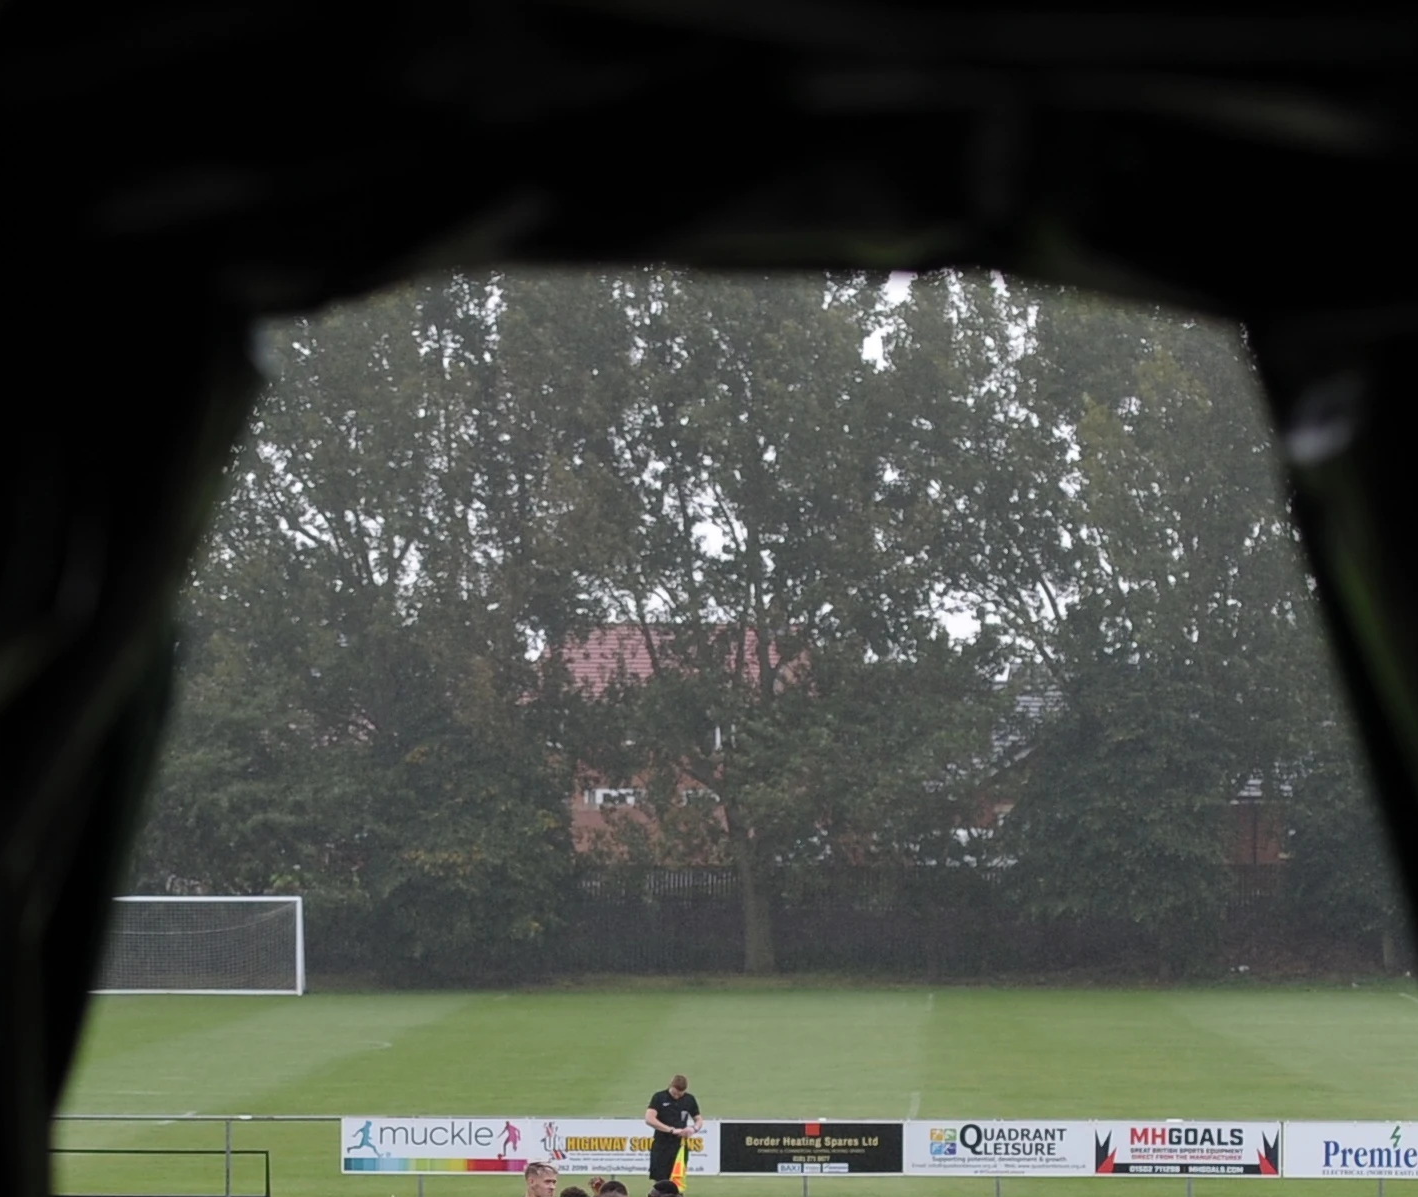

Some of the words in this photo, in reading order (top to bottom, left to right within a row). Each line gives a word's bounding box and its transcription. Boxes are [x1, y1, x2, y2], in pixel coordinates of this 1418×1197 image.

[379, 1121, 493, 1146] muckle
[959, 1124, 1067, 1156] QUADRANT
[1130, 1128, 1244, 1146] MHGOALS
[566, 1136, 627, 1152] HIGHWAY
[745, 1137, 780, 1147] Border
[783, 1136, 821, 1149] Heating
[824, 1136, 859, 1149] Spares
[863, 1136, 879, 1147] Ltd
[983, 1143, 1056, 1156] LEISURE
